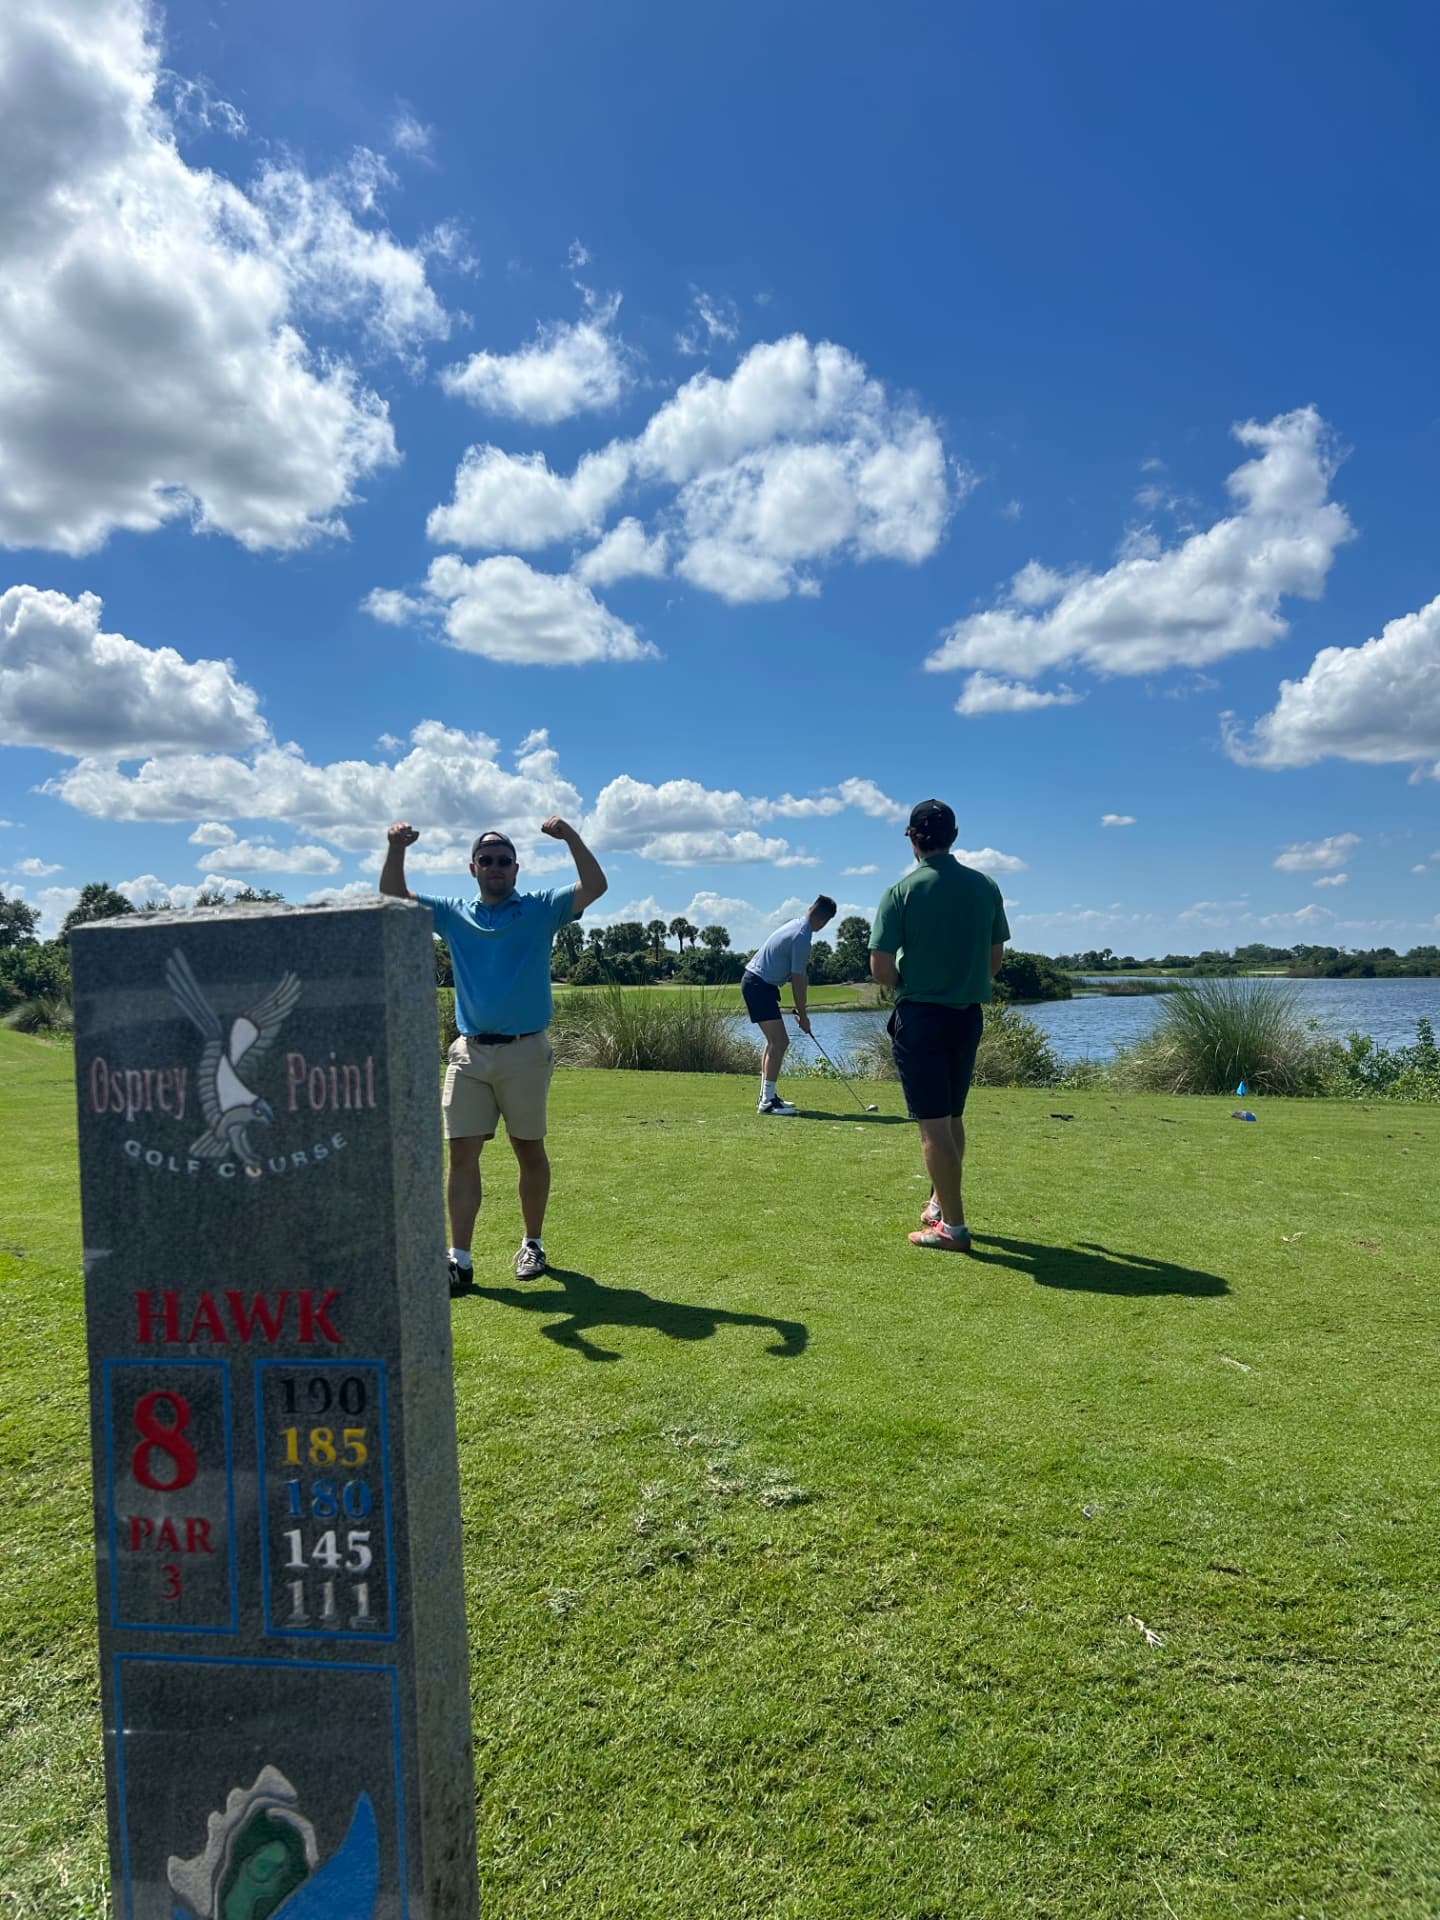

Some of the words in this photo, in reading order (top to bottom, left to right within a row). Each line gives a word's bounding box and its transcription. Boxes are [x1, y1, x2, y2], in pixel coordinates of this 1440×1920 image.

[89, 1056, 187, 1122] Osprey
[286, 1051, 377, 1112] Point
[123, 1138, 201, 1175] GOLF
[132, 1288, 343, 1344] HAWK
[280, 1375, 368, 1416] 190
[131, 1390, 198, 1492] 8
[280, 1426, 368, 1468] 185
[282, 1478, 372, 1519] 180
[127, 1515, 214, 1554] PAR
[283, 1528, 374, 1573] 145
[160, 1563, 183, 1600] 3
[282, 1579, 377, 1629] 111
